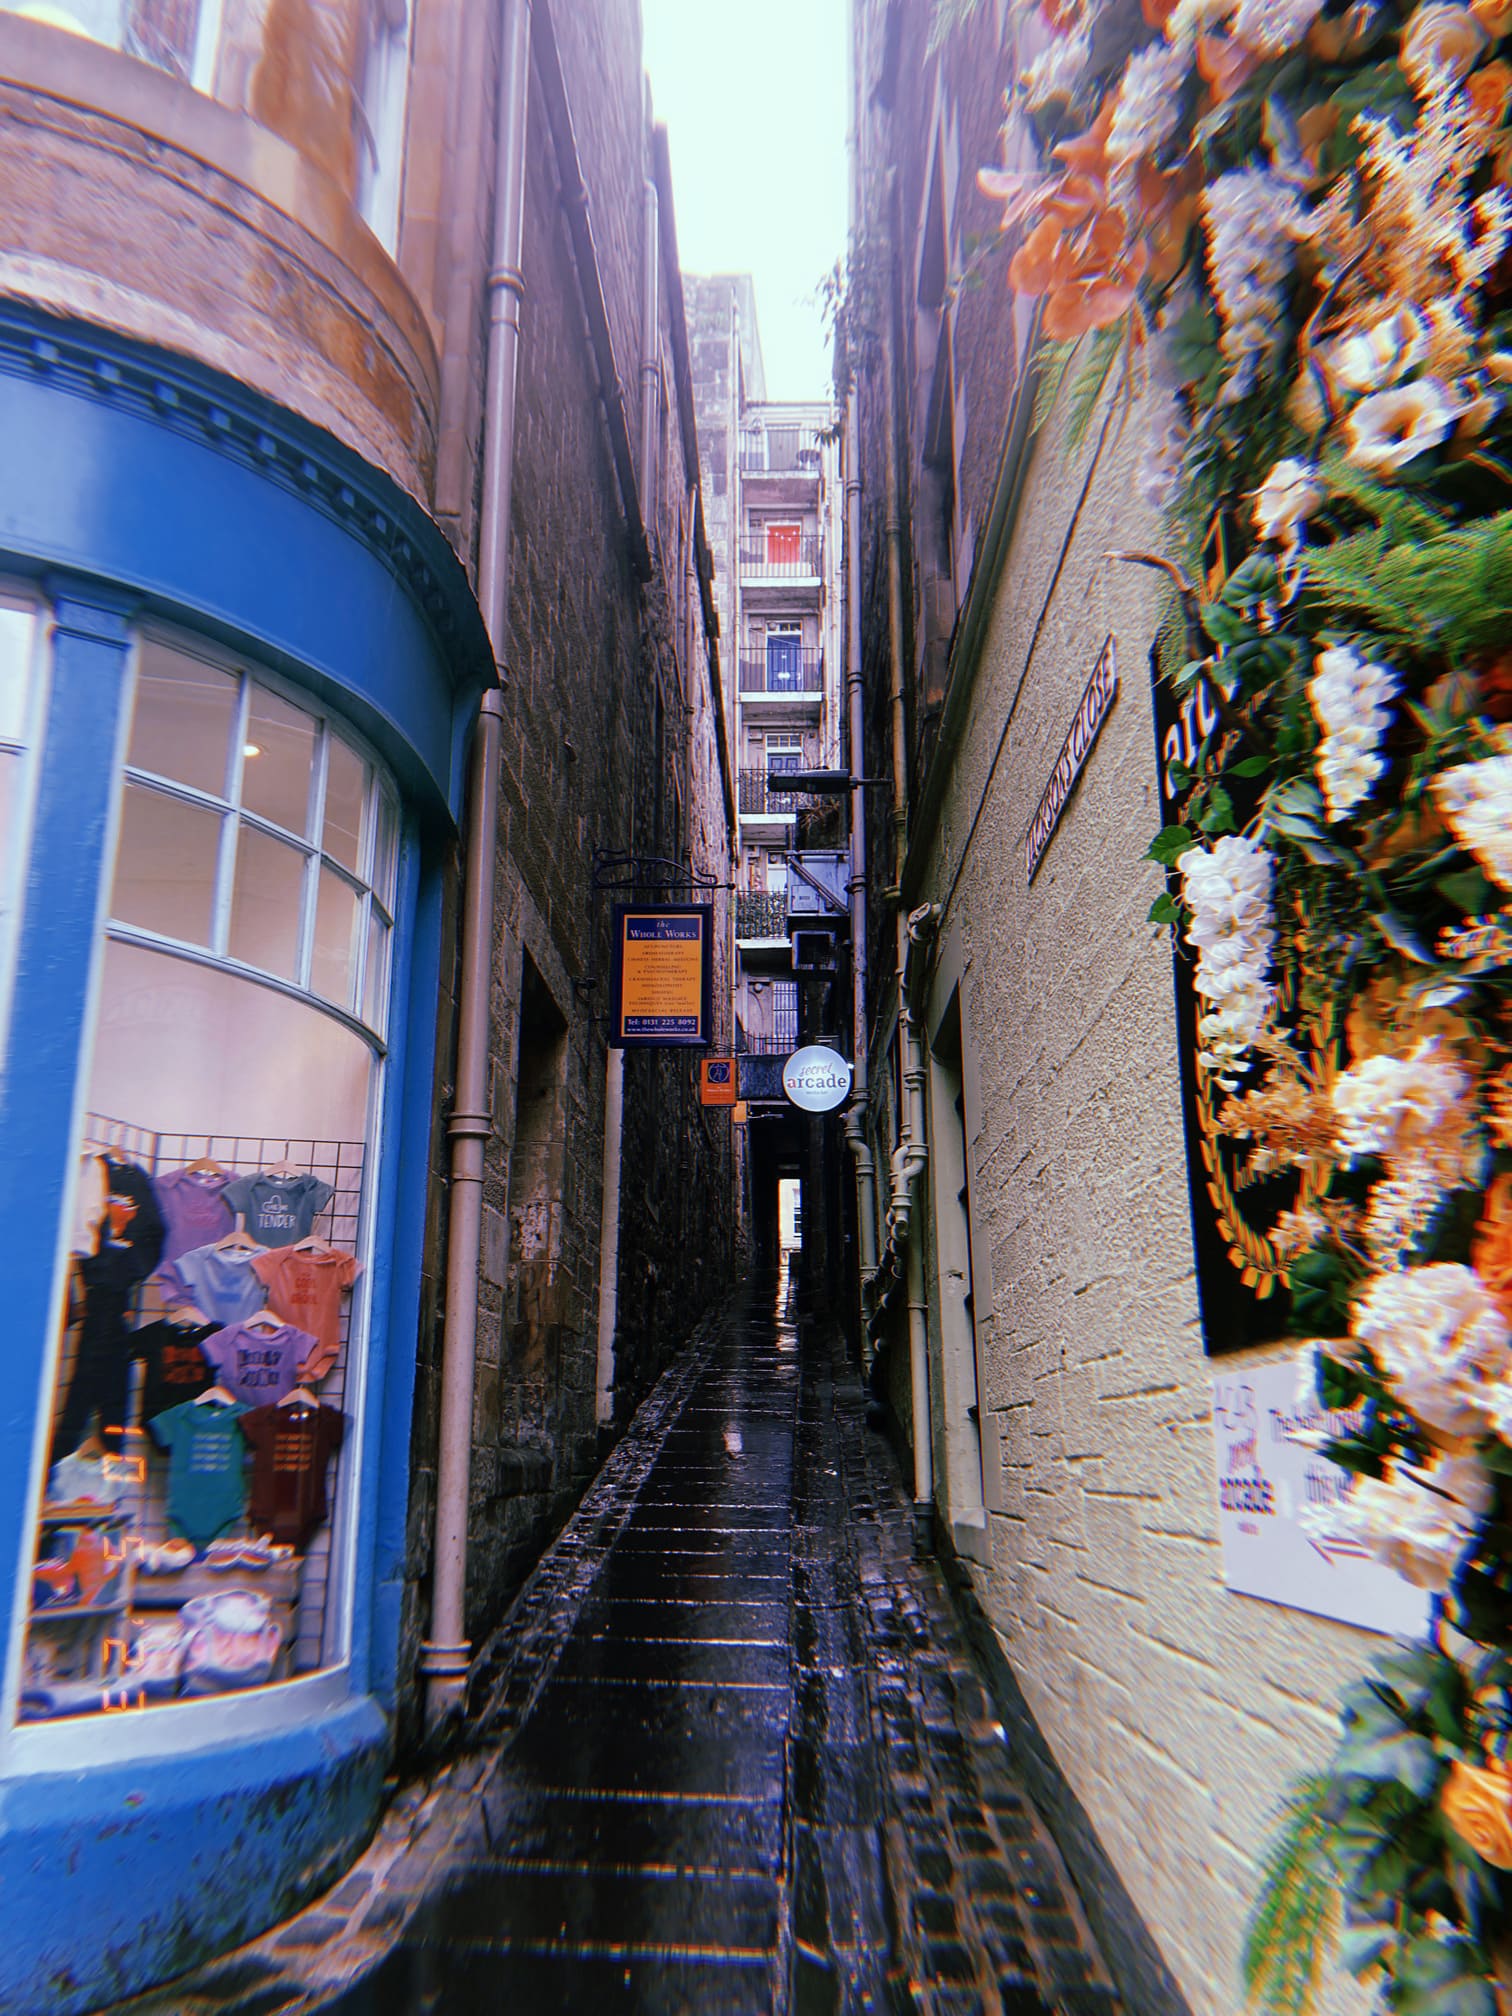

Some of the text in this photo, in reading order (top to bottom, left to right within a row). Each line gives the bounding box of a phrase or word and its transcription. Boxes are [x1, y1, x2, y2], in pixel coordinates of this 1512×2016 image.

[1073, 652, 1112, 764] CLOSE
[656, 920, 671, 928] the
[642, 1018, 658, 1026] 0131
[661, 1018, 675, 1026] 225
[786, 1074, 847, 1089] arcade
[256, 1213, 297, 1229] TENDER
